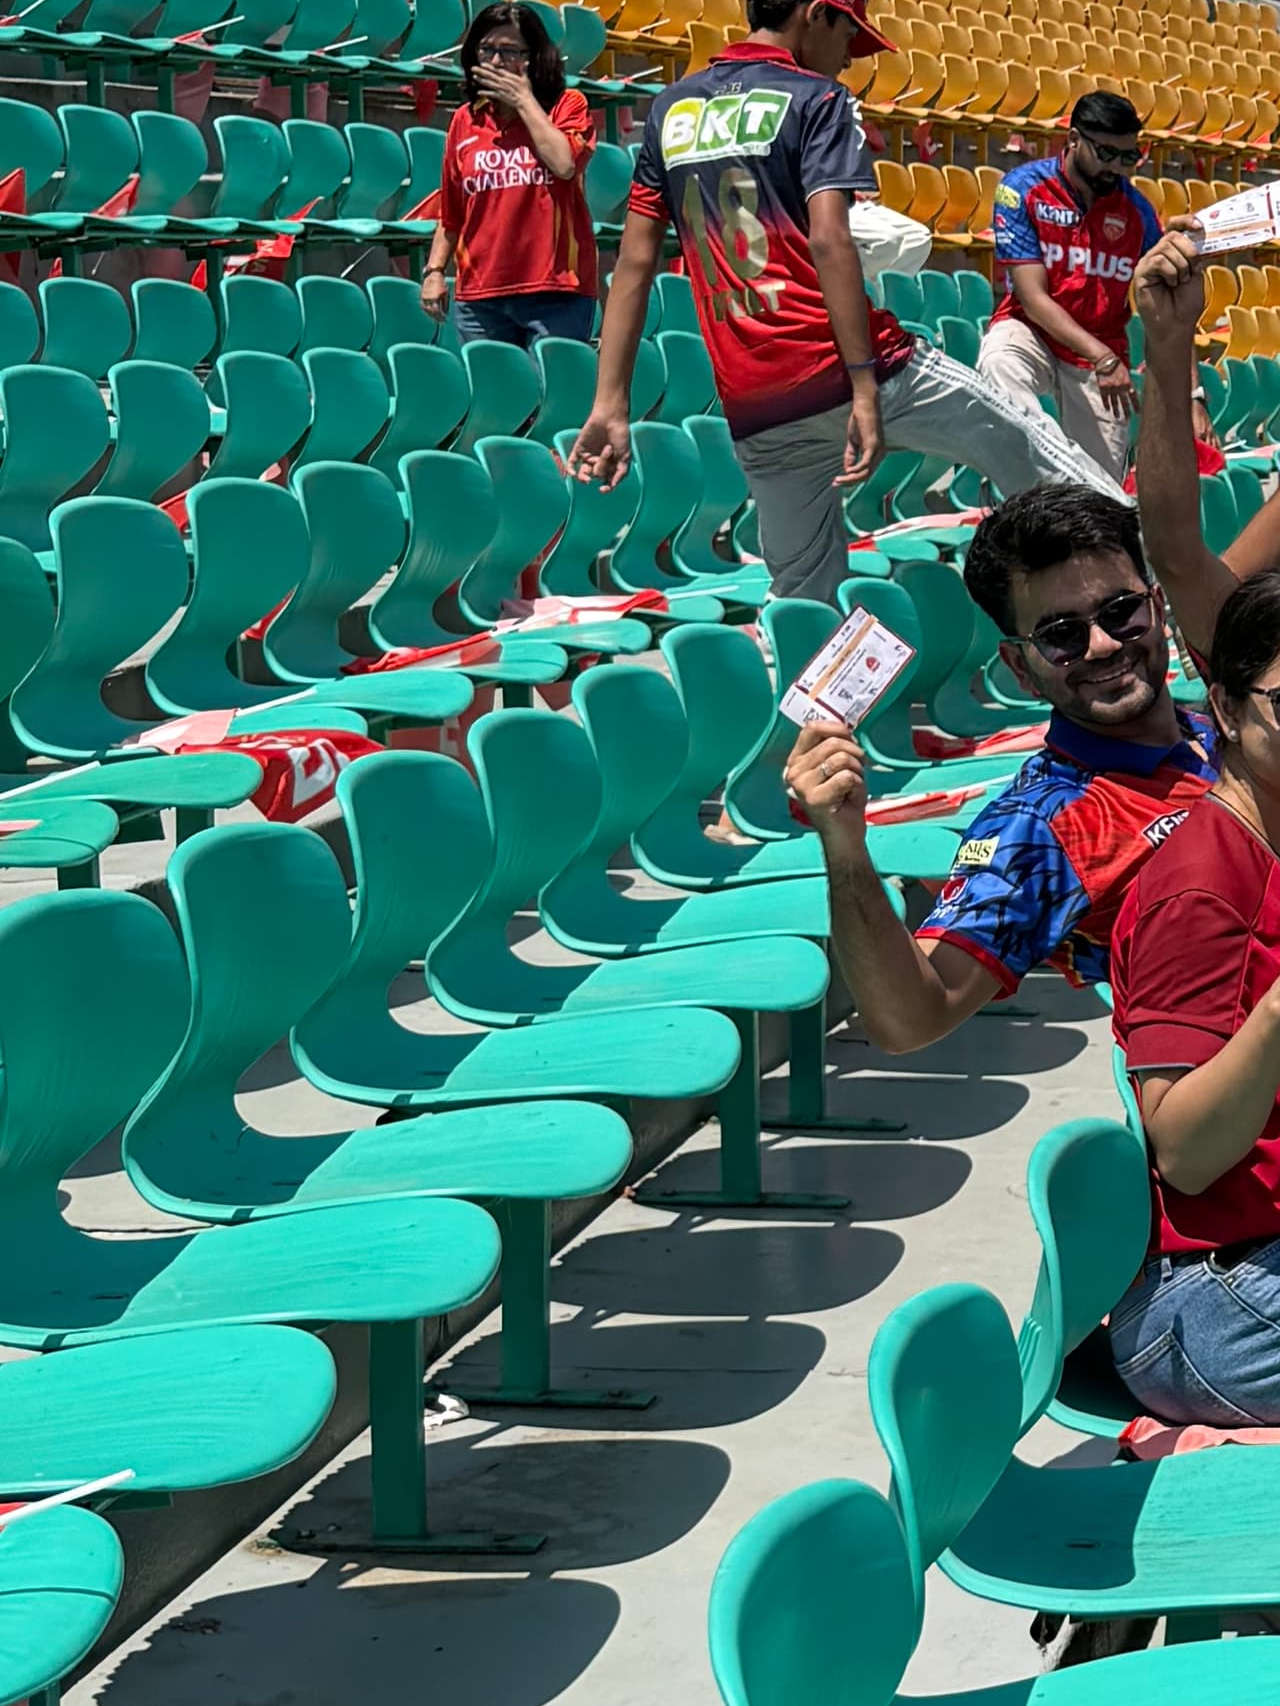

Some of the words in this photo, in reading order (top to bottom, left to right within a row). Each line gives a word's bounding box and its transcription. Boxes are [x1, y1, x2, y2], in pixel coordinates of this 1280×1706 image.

[664, 101, 781, 151] BKT
[474, 146, 538, 171] ROYAL
[683, 168, 769, 287] 18
[1068, 246, 1133, 283] PLUS
